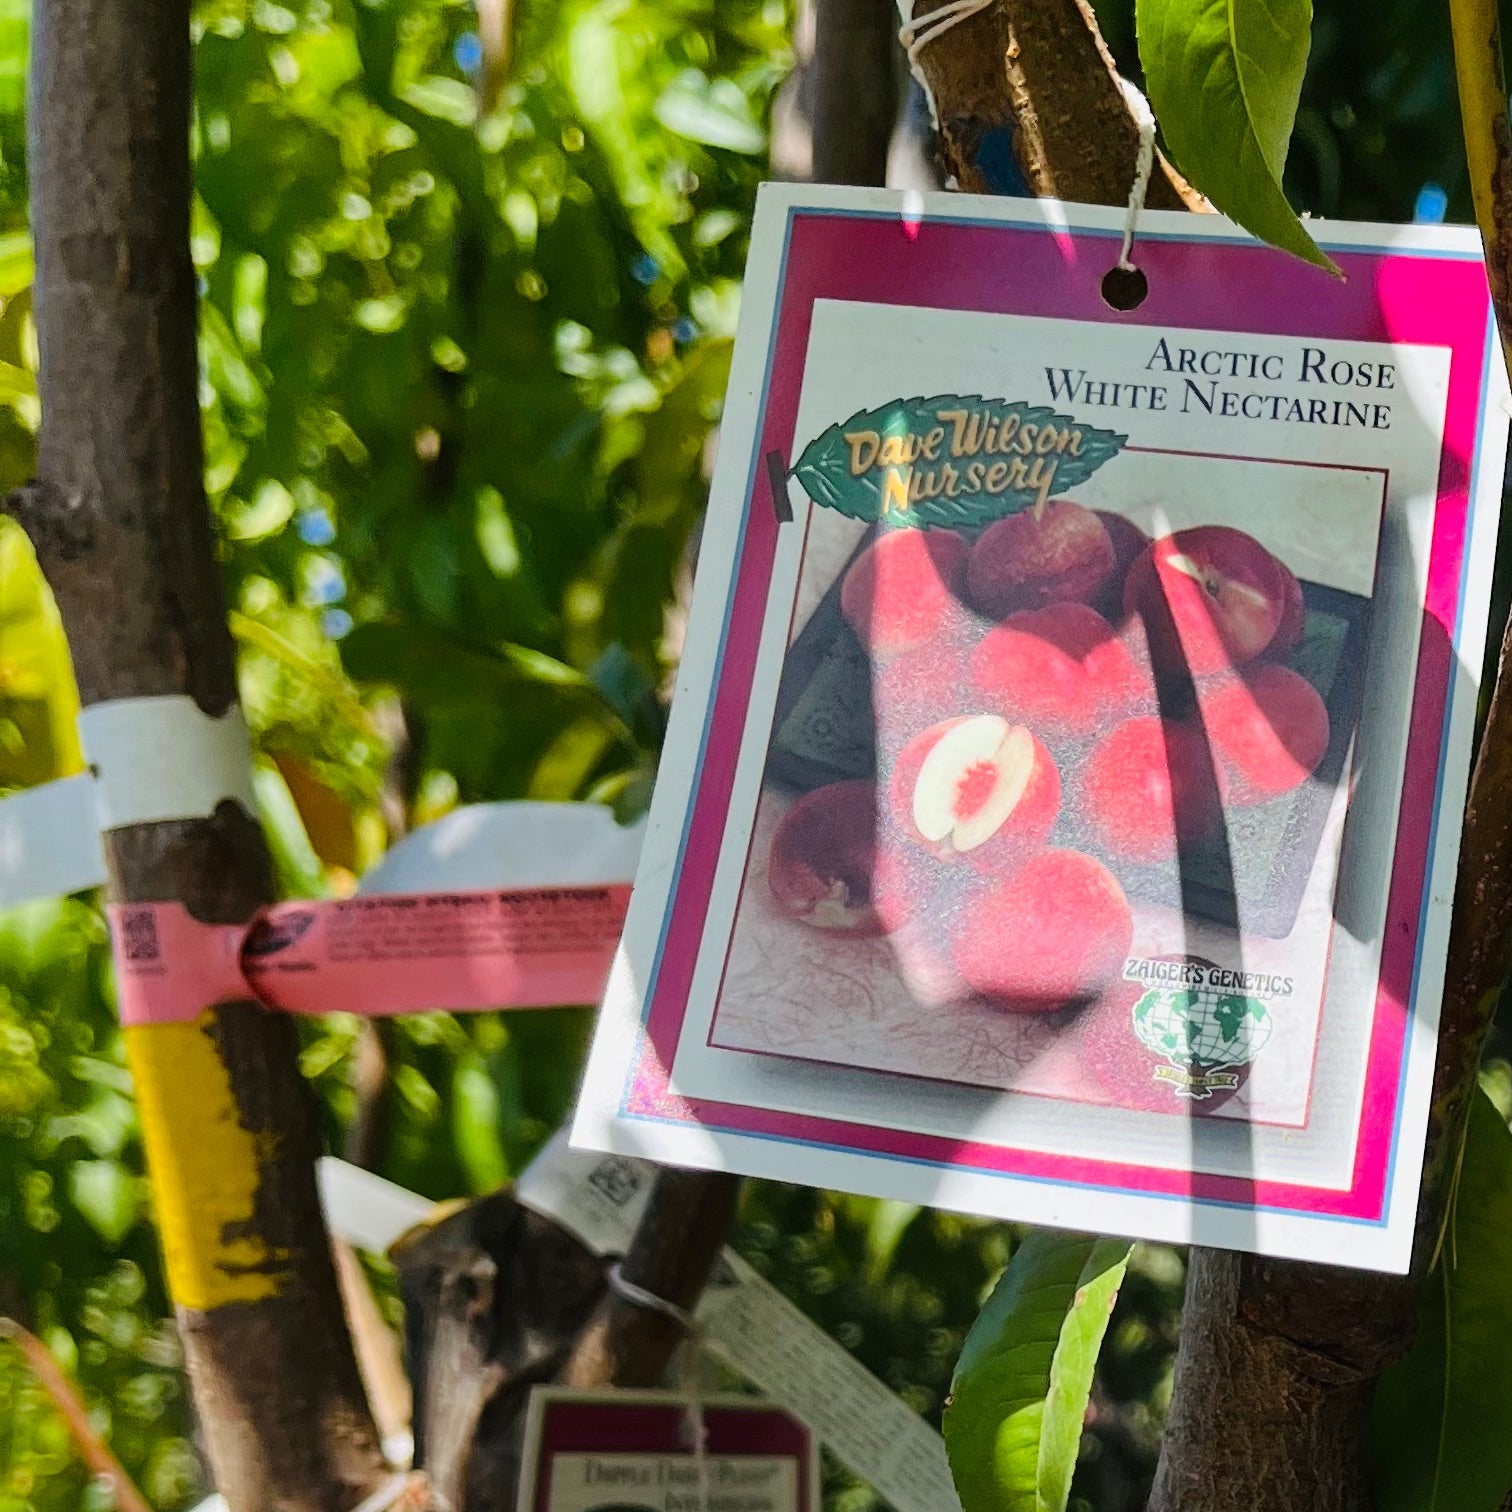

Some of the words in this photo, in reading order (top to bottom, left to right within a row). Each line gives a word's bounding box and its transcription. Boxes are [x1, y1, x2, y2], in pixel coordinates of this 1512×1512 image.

[1145, 337, 1284, 383] ARCTIC
[1300, 348, 1396, 391] ROSE
[1044, 367, 1168, 413] WHITE
[1181, 380, 1392, 430] NECTARINE
[845, 422, 943, 475] Dave
[936, 409, 1085, 458] Wilson
[881, 457, 1060, 522] Nursery
[1126, 959, 1203, 984] ZAIGER'S
[1208, 968, 1294, 993] GENETICS
